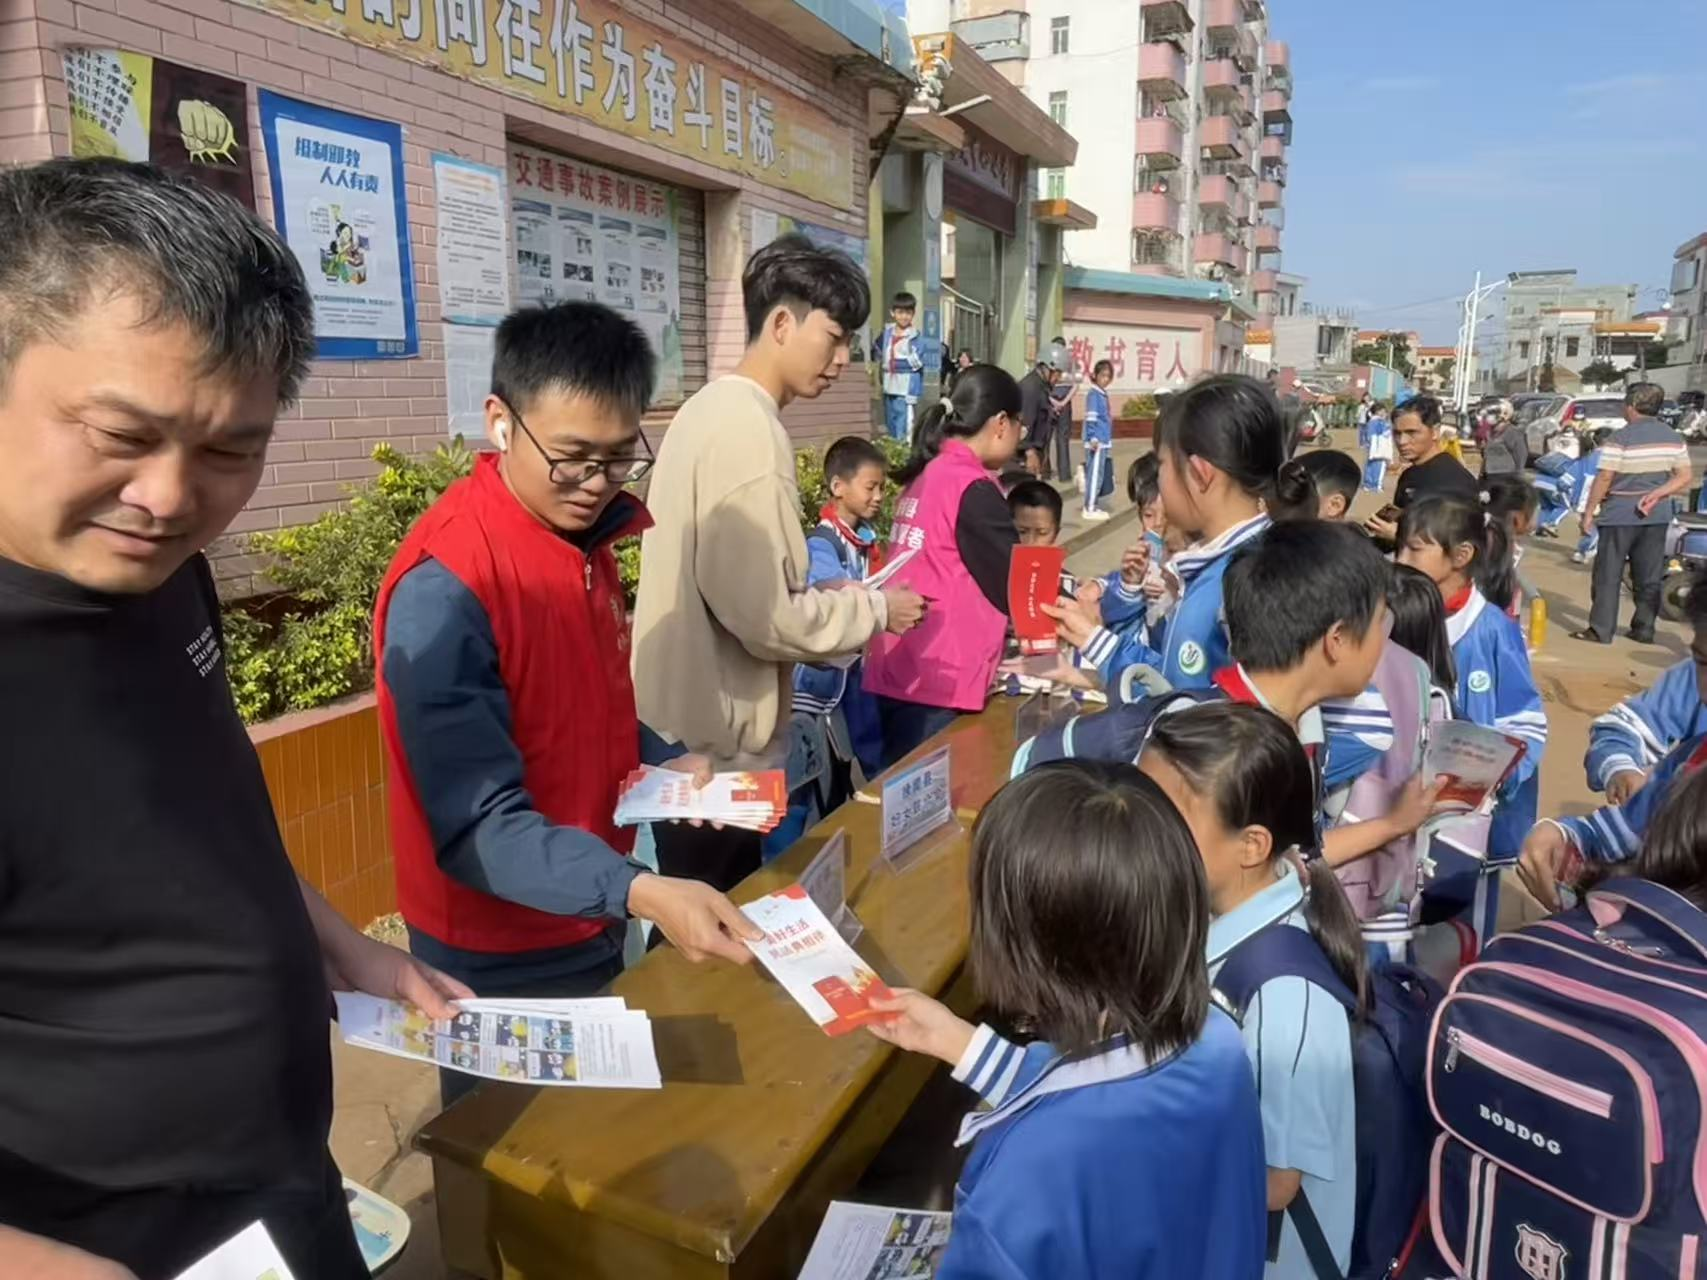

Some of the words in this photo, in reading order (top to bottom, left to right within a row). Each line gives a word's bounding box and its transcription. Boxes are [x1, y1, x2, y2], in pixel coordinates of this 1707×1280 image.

[320, 166, 379, 194] 人人有责
[513, 151, 666, 218] 交通事故案例展示
[1069, 335, 1188, 382] 教书育人
[1479, 1104, 1562, 1155] BOBDOG
